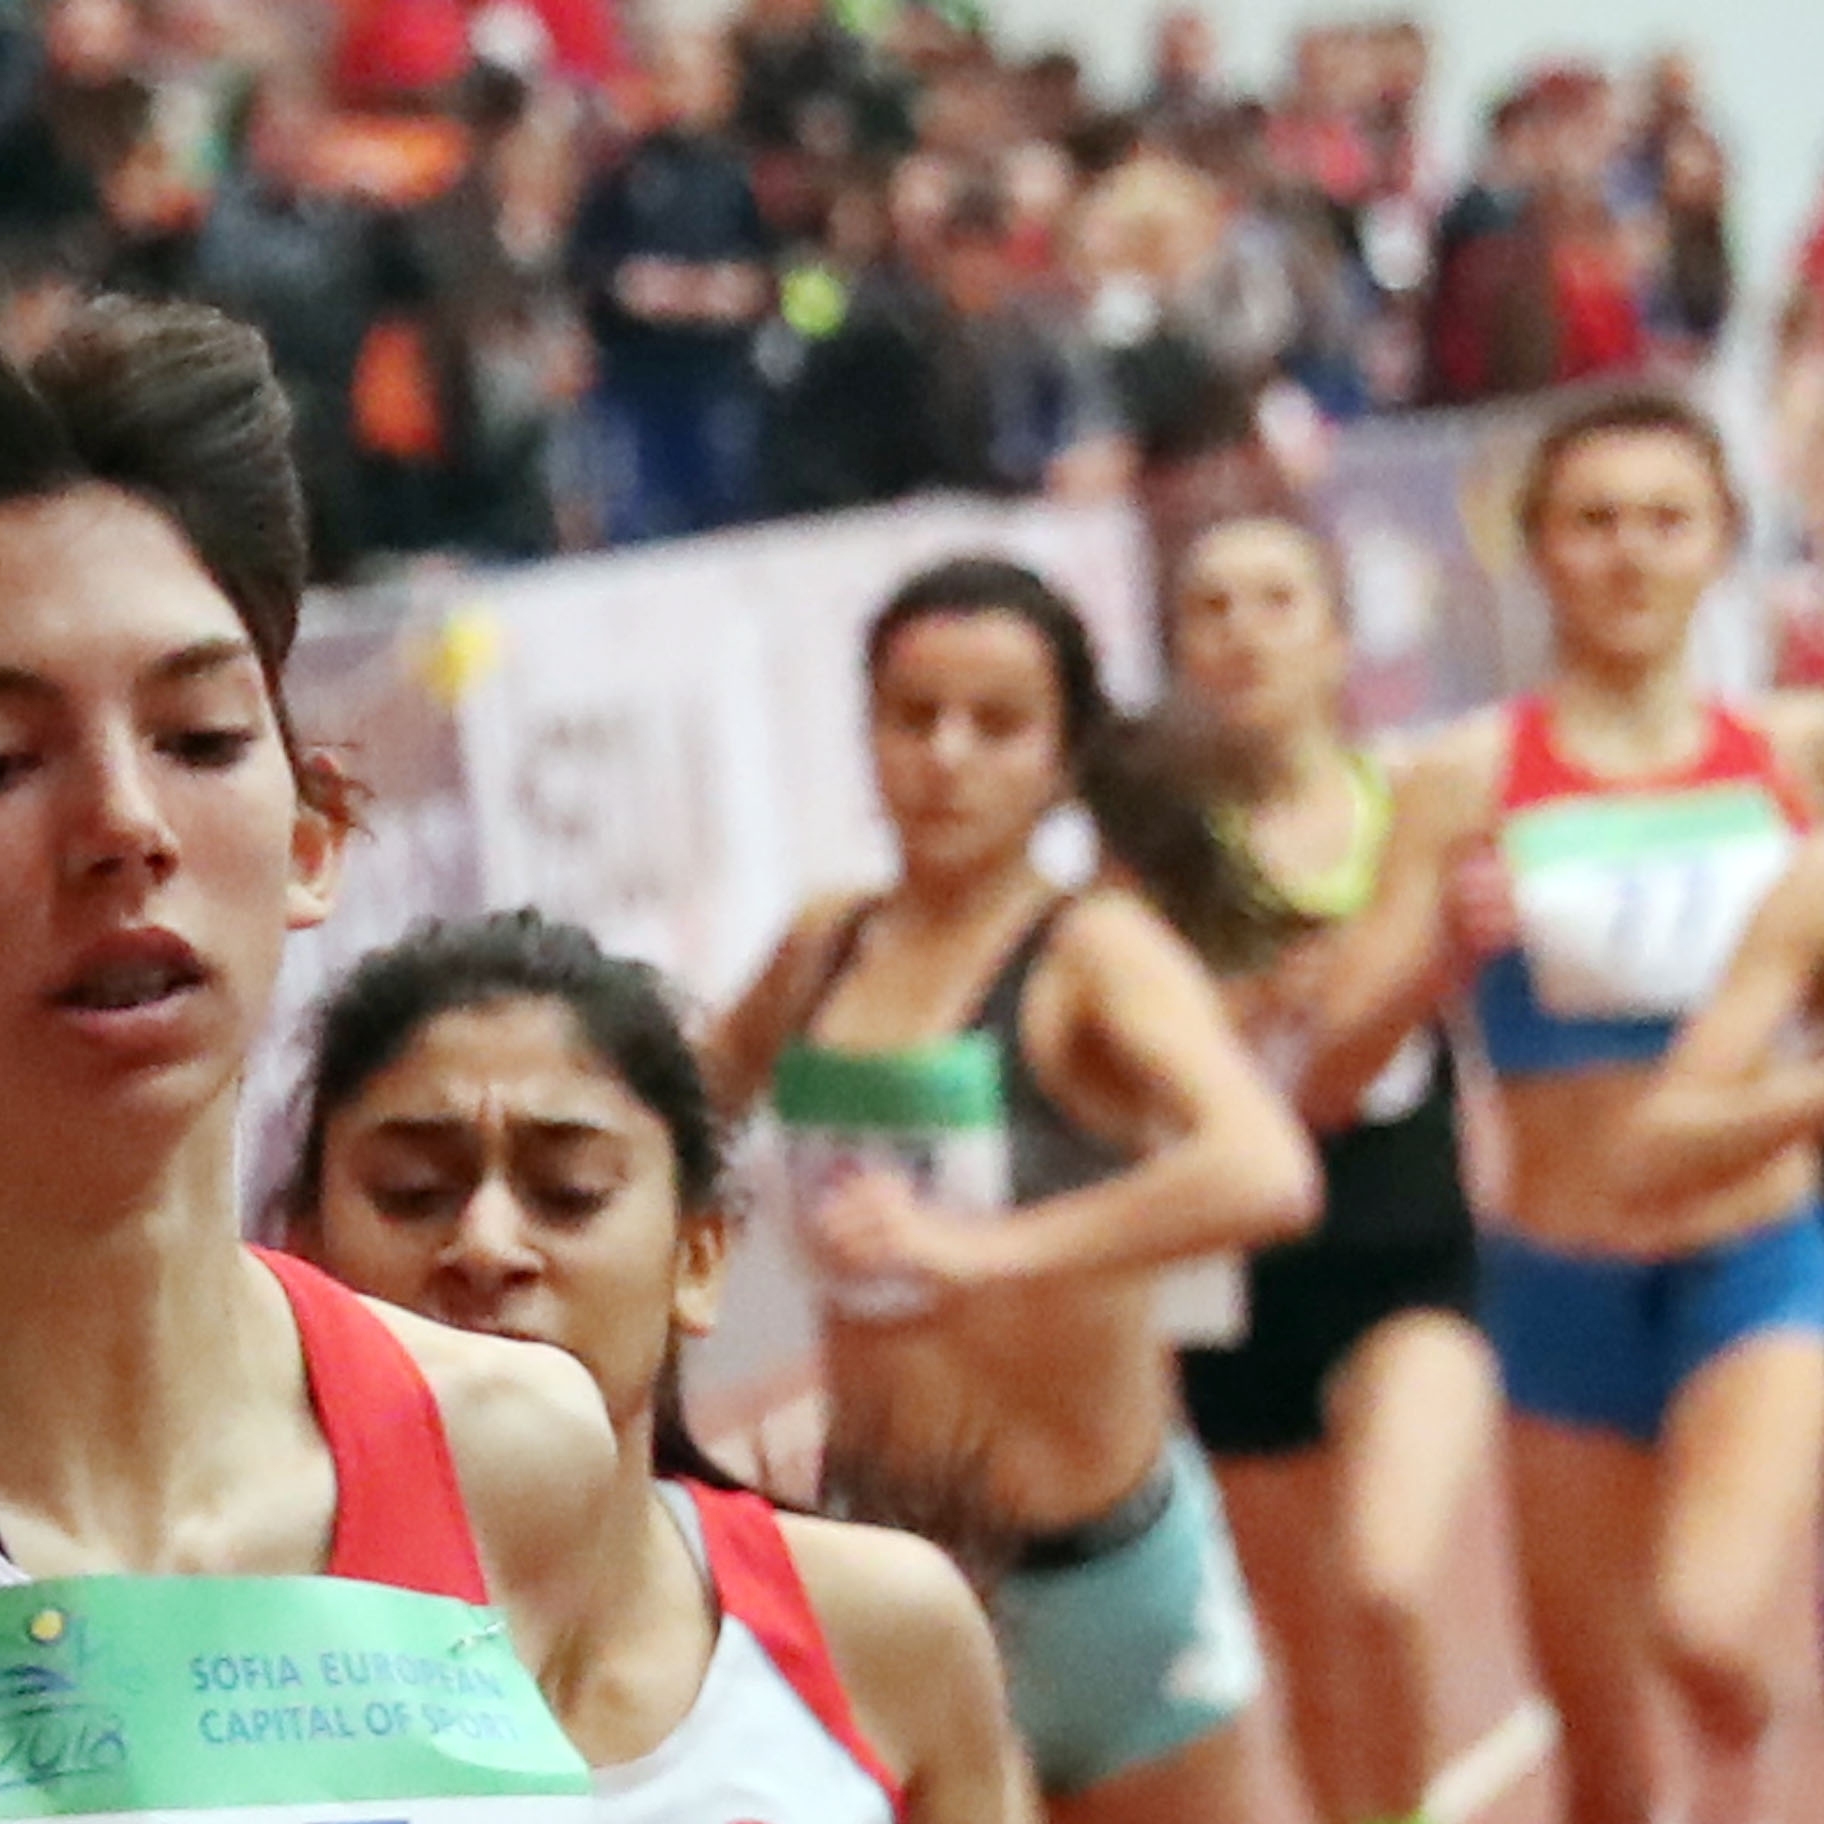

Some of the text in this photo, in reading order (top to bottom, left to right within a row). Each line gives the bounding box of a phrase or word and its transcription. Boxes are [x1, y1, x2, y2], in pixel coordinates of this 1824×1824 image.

[188, 1650, 506, 1699] SOFIA EUROPEAN
[197, 1700, 520, 1744] CAPITAL OF SPORT
